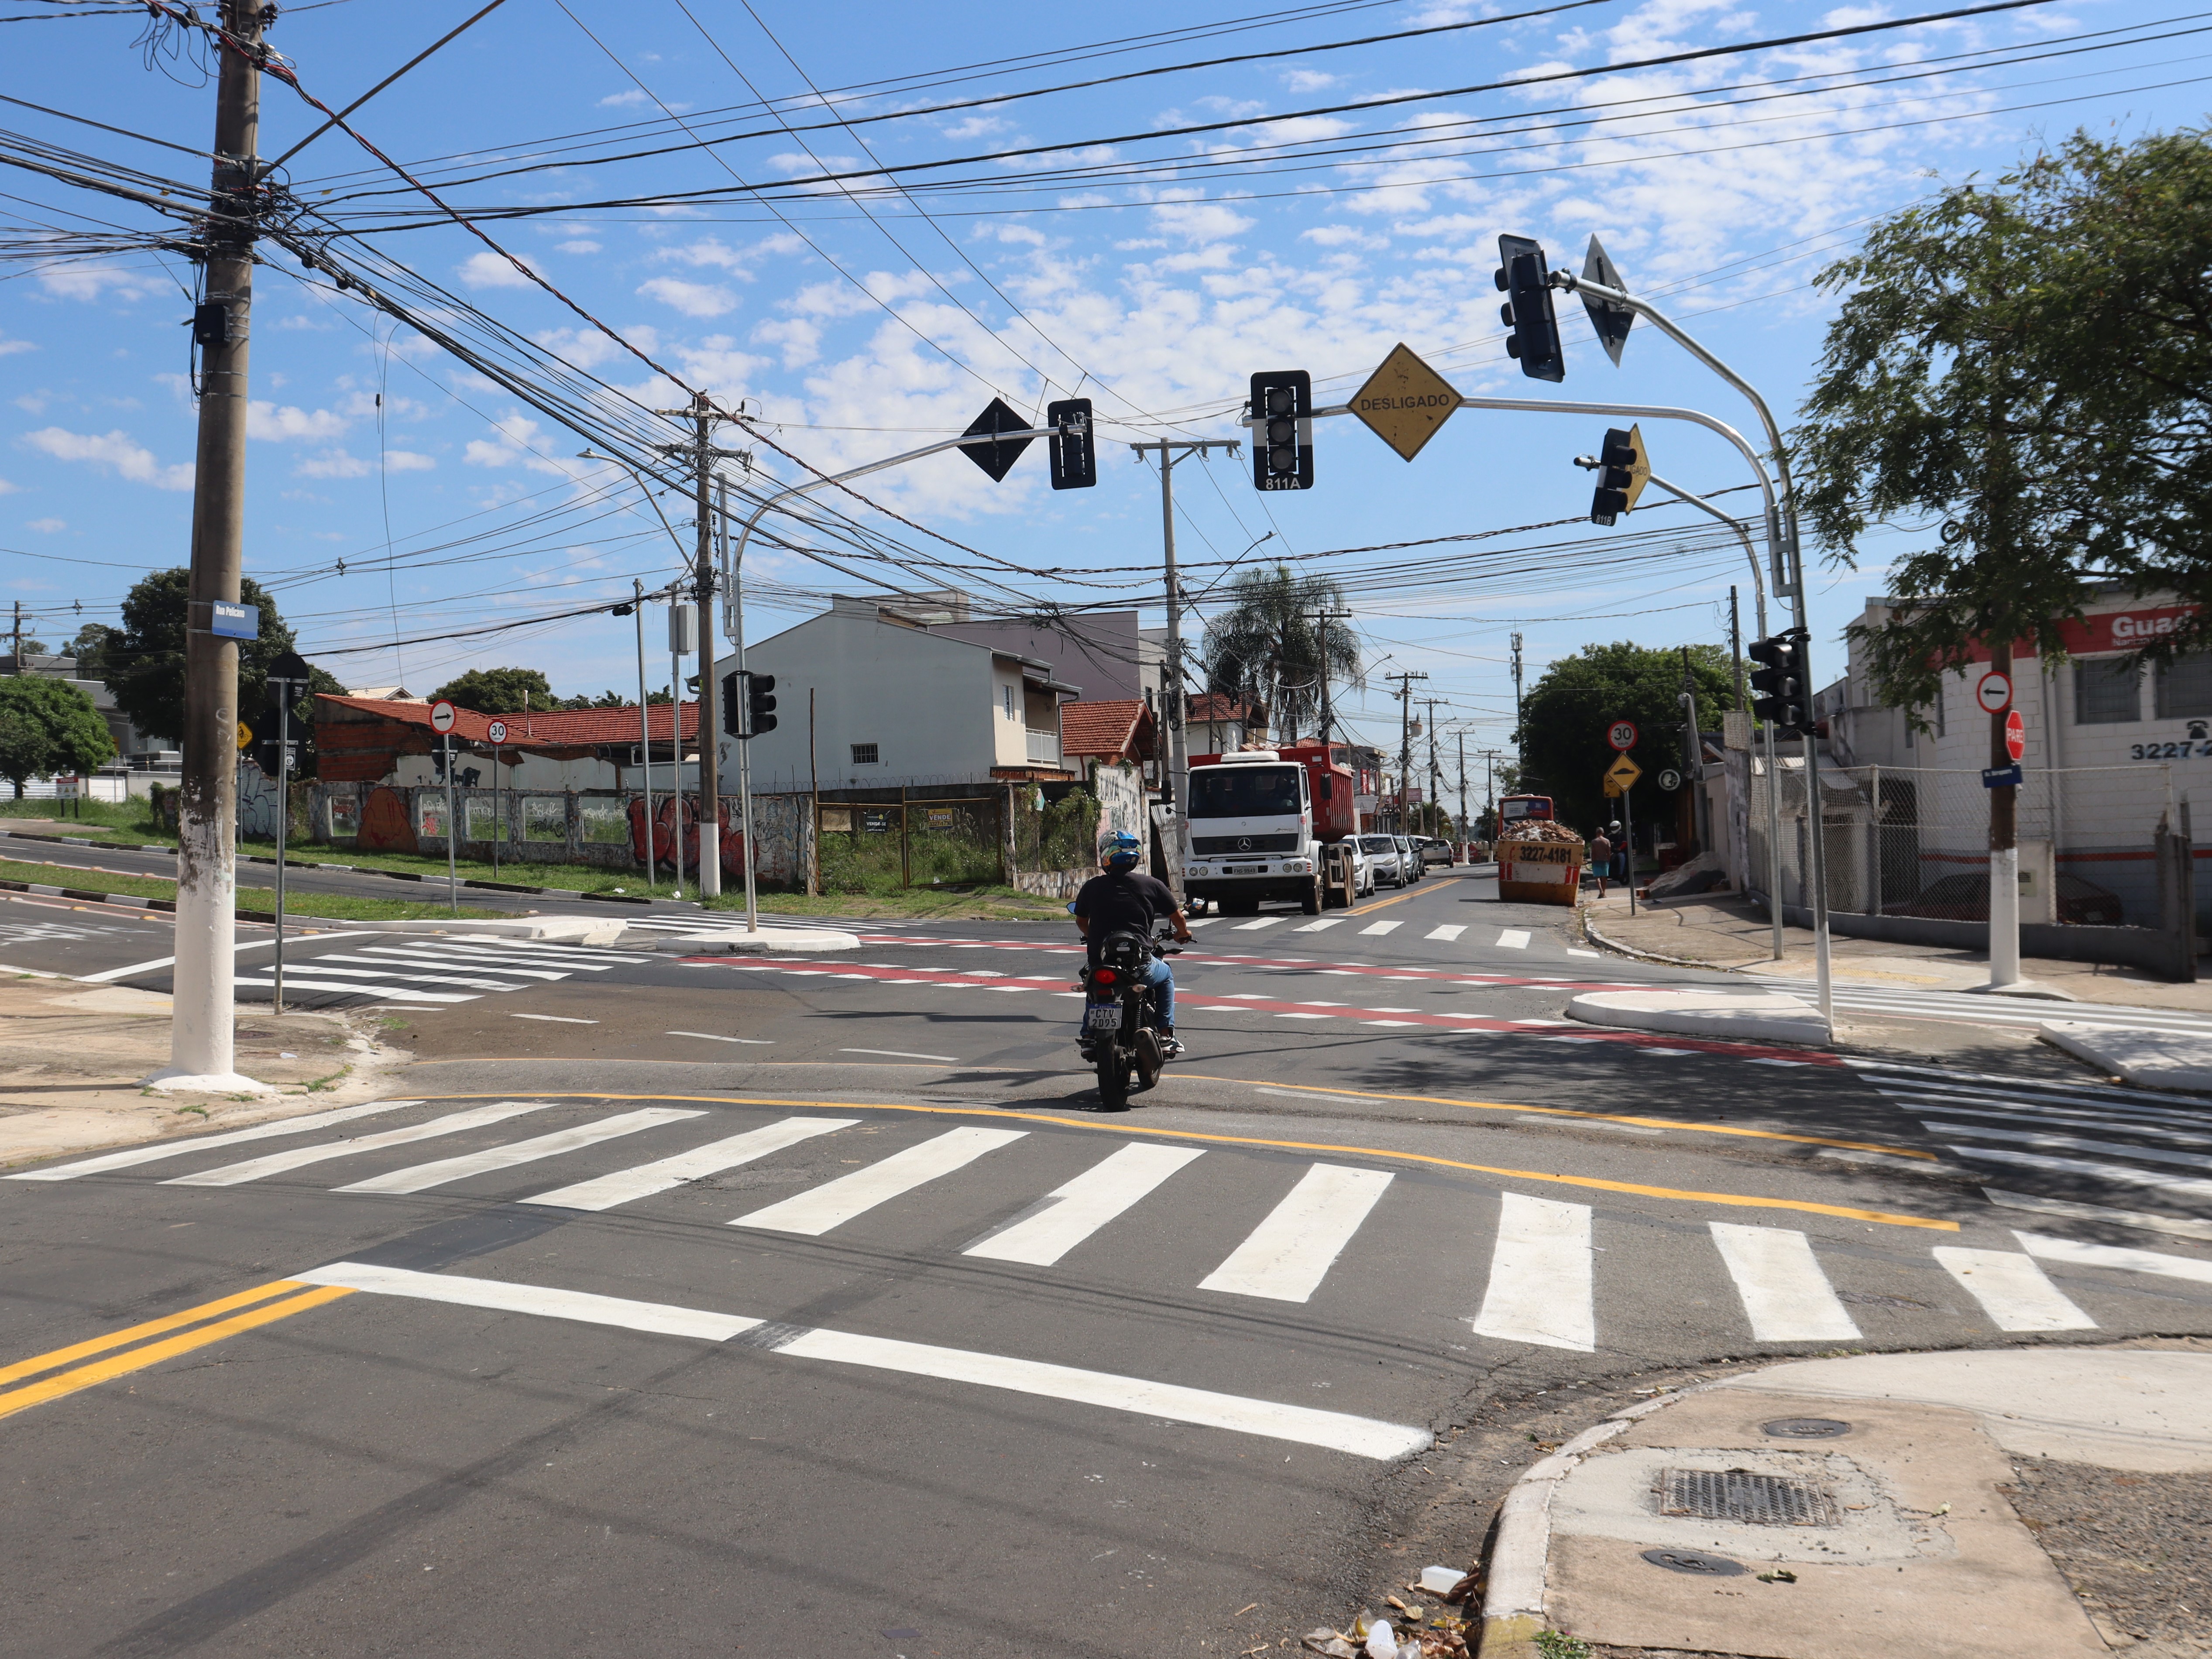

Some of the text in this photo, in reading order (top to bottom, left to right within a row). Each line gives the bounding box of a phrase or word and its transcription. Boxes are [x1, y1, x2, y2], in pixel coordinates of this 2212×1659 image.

[1361, 394, 1449, 411] DESLIGADO
[1266, 477, 1301, 490] 811A
[1596, 514, 1612, 526] 811B
[216, 605, 245, 618] Rua Pelicano
[491, 725, 504, 735] 30
[1614, 727, 1632, 740] 30
[2007, 728, 2024, 743] PARE
[1520, 846, 1572, 863] 3227-4181
[1096, 1009, 1115, 1018] CTV
[1092, 1018, 1116, 1028] 2D95
